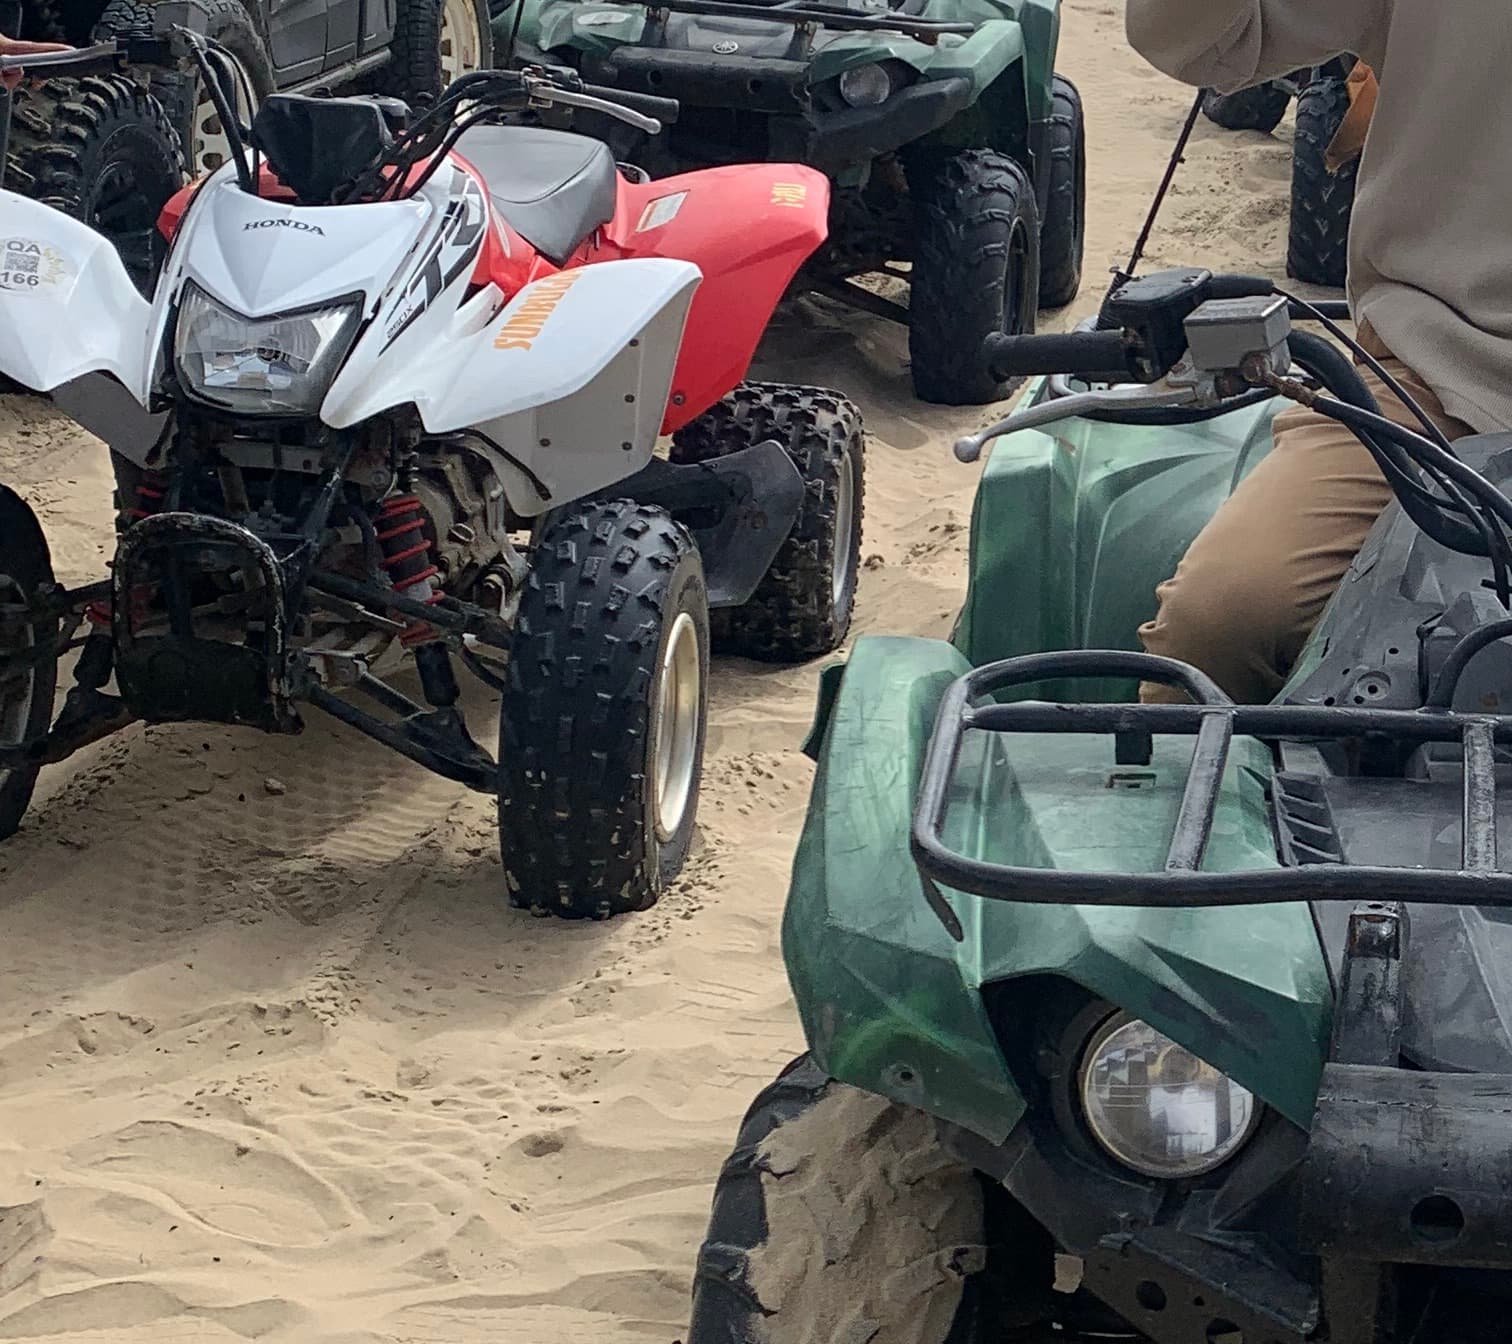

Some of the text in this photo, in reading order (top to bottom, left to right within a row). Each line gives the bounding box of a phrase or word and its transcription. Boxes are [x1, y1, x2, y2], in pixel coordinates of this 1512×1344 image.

[243, 218, 326, 237] HONDA
[7, 240, 42, 256] QA
[1, 271, 39, 287] 166
